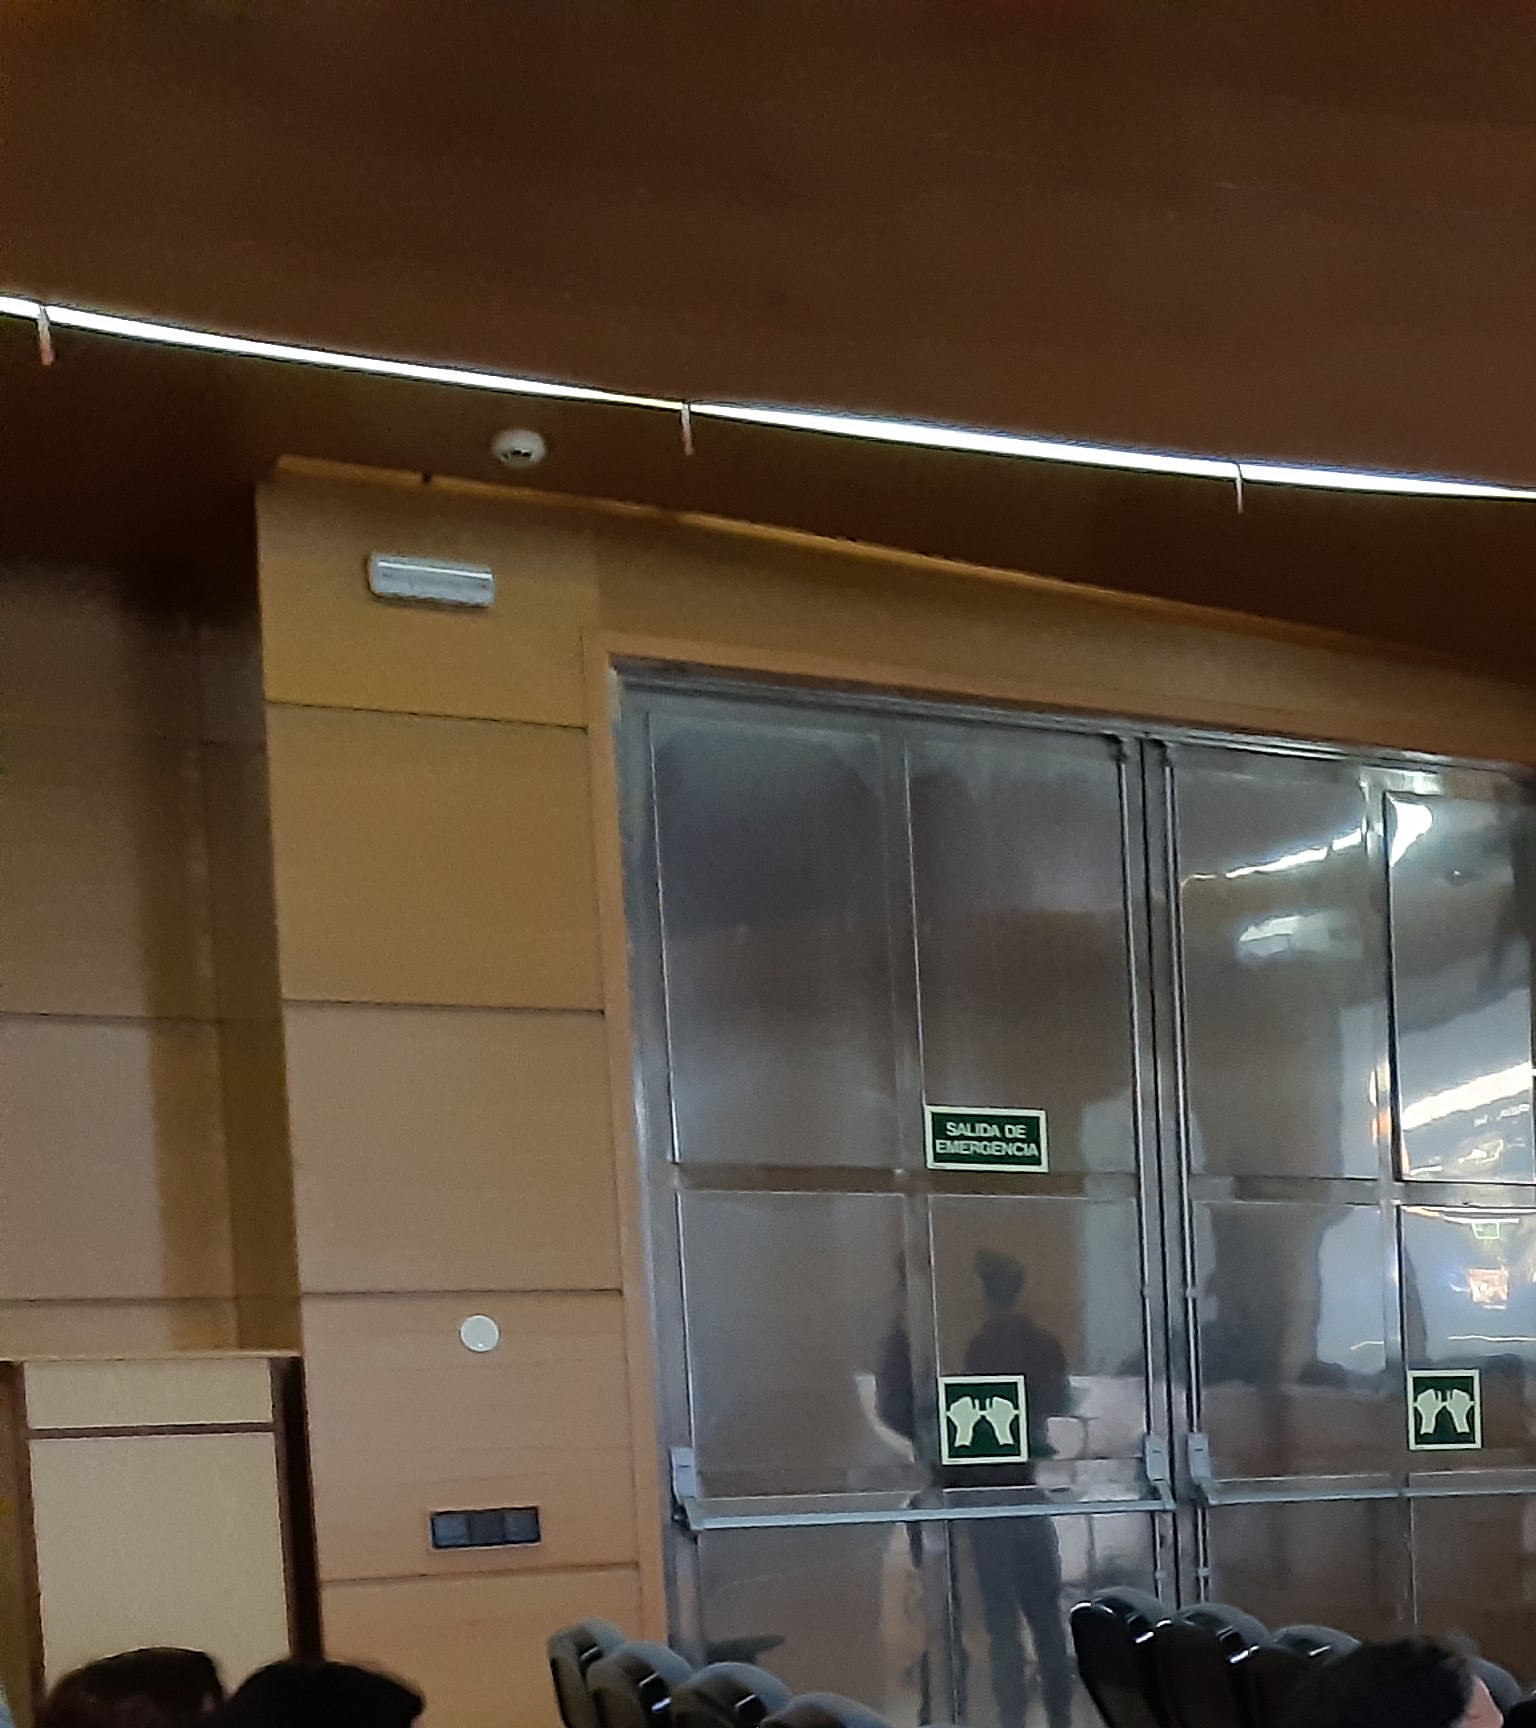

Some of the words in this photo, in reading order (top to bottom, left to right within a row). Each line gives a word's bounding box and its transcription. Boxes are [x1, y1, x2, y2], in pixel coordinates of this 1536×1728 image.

[946, 1121, 1001, 1138] SALIDA
[1004, 1124, 1027, 1139] DE
[935, 1139, 1040, 1157] EMERGENCIA
